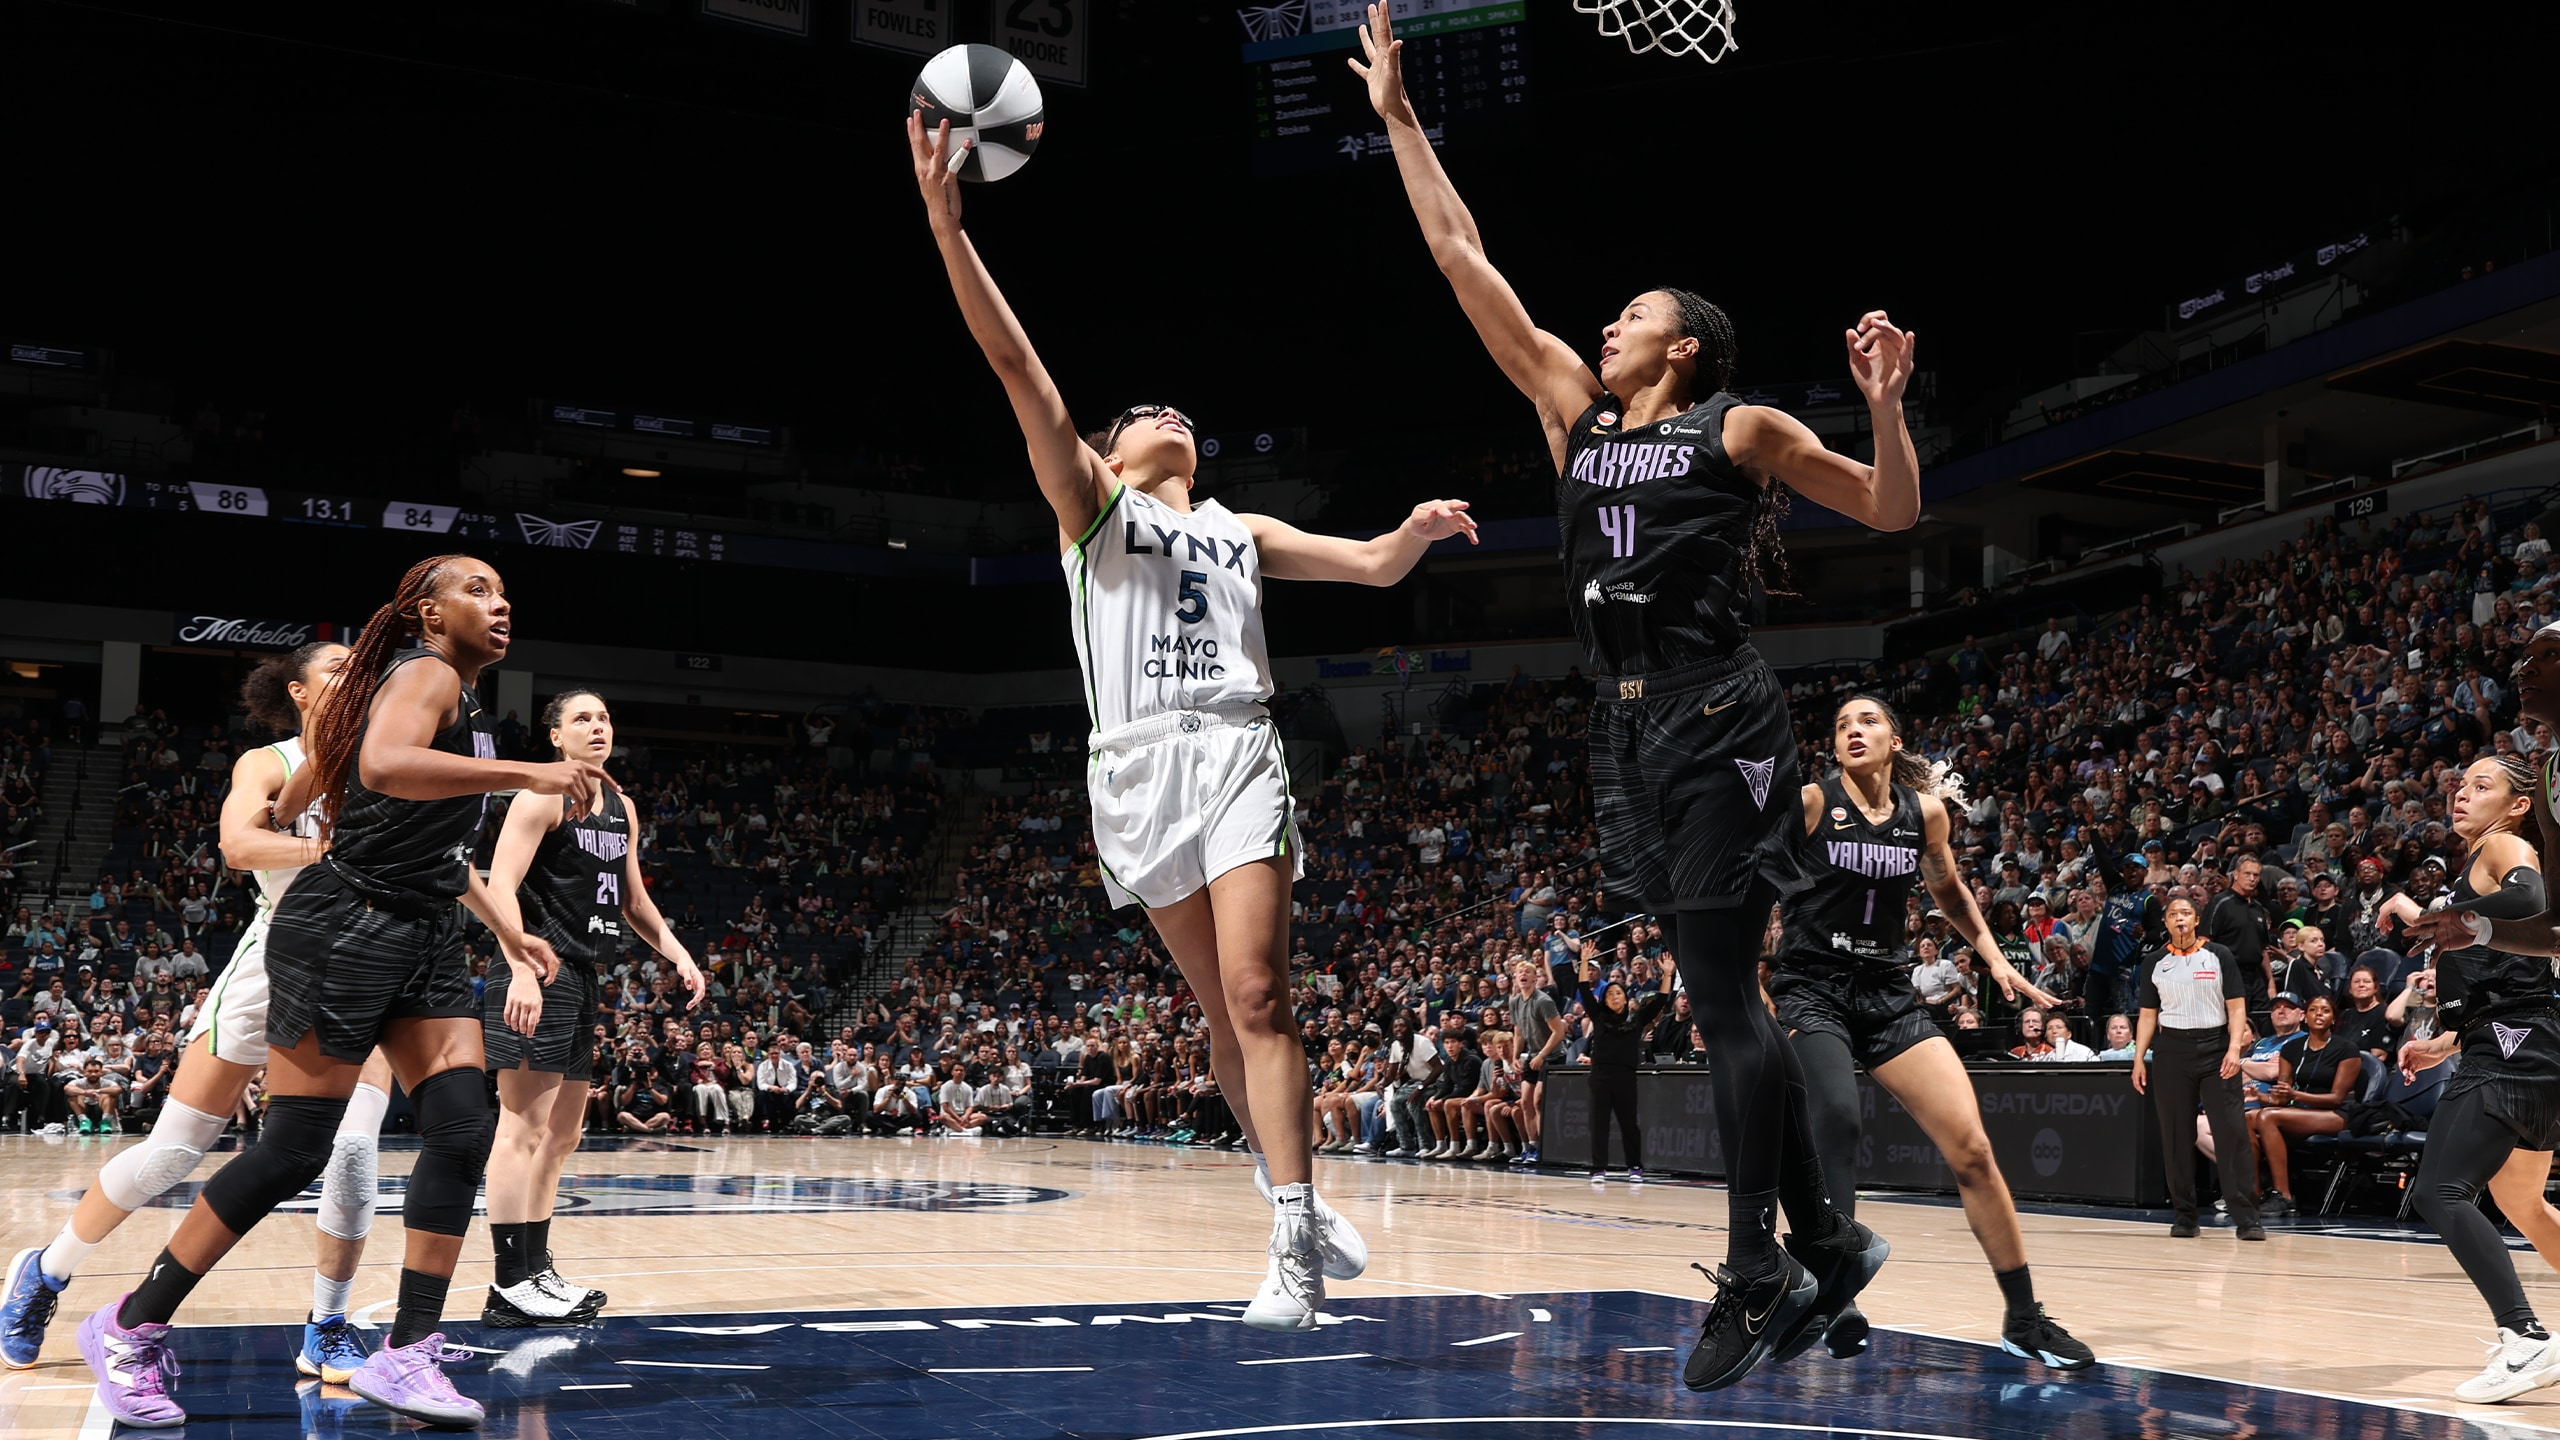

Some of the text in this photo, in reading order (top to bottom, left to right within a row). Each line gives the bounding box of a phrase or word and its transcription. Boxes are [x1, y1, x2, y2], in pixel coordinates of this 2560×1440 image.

[868, 8, 936, 39] FOWLES
[1009, 36, 1068, 66] MOORE
[1673, 425, 1702, 436] freedom
[1571, 441, 1695, 489] VALKYRIES
[144, 482, 190, 495] TO FLS
[218, 490, 248, 511] 86
[302, 498, 352, 522] 13.1
[405, 508, 433, 528] 84
[459, 512, 497, 524] FLS TO
[2347, 496, 2374, 517] 129
[618, 535, 637, 543] AST
[1597, 504, 1636, 559] 41
[1125, 521, 1248, 578] LYNX
[1175, 569, 1208, 624] 5
[1605, 581, 1635, 593] KAISER
[178, 615, 313, 647] Michelob
[1151, 634, 1218, 658] MAYO
[687, 656, 711, 669] 122
[1144, 659, 1225, 681] CLINIC
[1315, 650, 1472, 679] Treasure Island
[575, 827, 628, 863] VALKYRIES
[1826, 840, 1919, 880] VALKYRIES
[596, 871, 619, 906] 24
[1862, 888, 1877, 925] 1
[2004, 950, 2031, 961] LYNX
[1982, 1092, 2126, 1117] SATURDAY
[1646, 1126, 1706, 1158] GOLDEN
[1886, 1144, 1931, 1164] 3PM
[2034, 1139, 2062, 1161] abc
